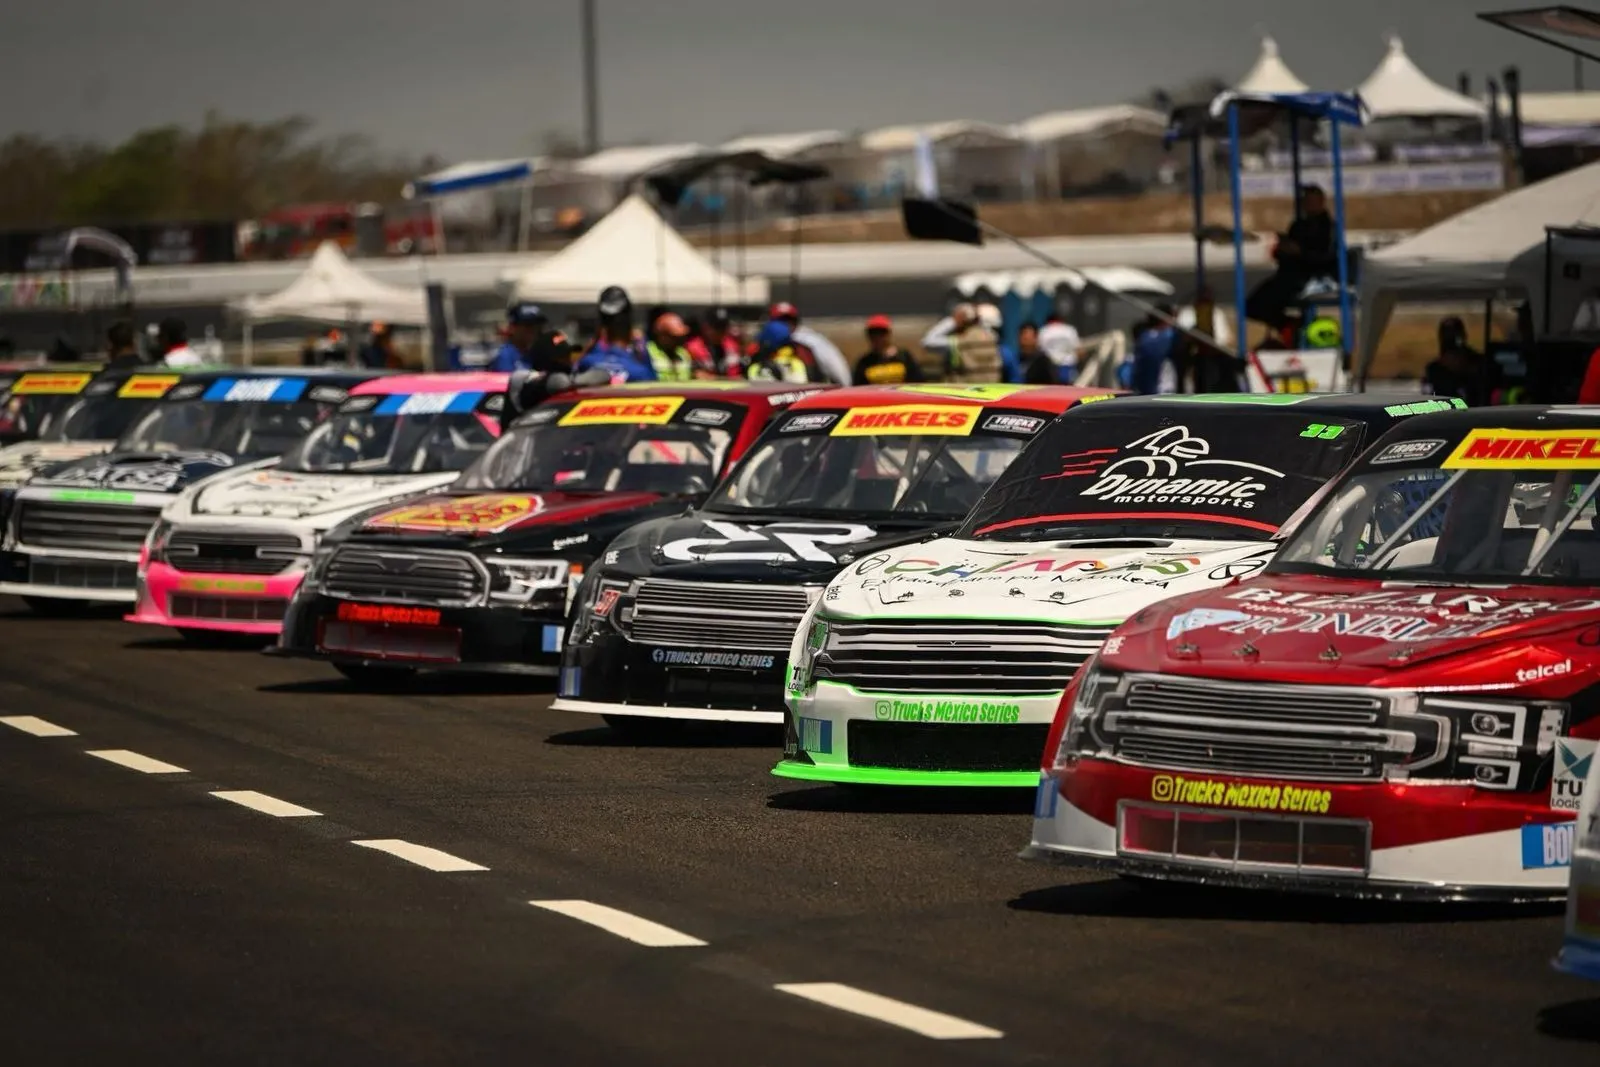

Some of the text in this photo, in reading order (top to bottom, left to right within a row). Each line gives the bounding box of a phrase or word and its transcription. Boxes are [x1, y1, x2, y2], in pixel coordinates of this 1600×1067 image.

[1300, 423, 1345, 440] 33
[1080, 474, 1266, 501] Dynamic
[1113, 494, 1256, 509] motorsports
[665, 650, 775, 668] TRUCKS MEXICO SERIES
[1516, 659, 1571, 682] telcel
[979, 702, 1020, 723] Series
[1174, 776, 1225, 805] Trucks
[1279, 786, 1332, 814] Series
